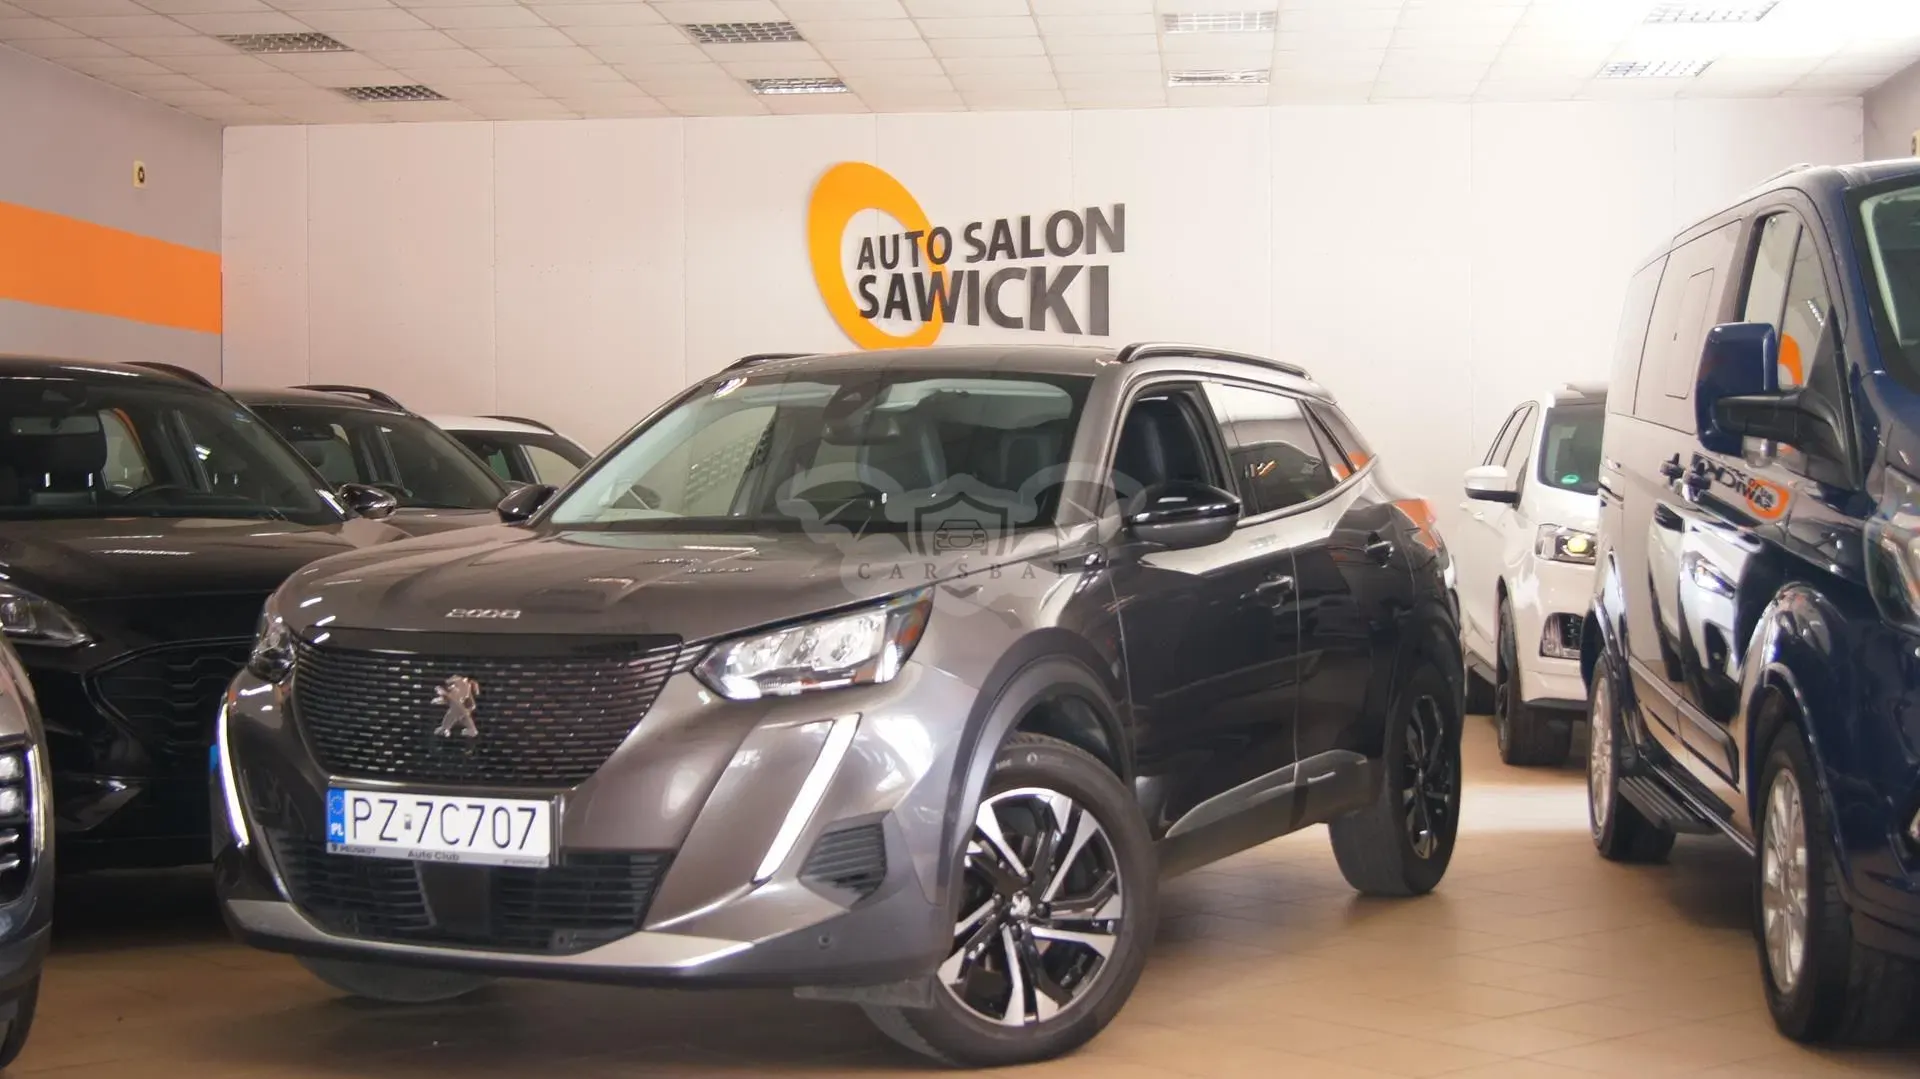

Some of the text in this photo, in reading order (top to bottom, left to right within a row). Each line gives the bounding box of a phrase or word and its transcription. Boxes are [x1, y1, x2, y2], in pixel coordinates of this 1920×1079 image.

[857, 203, 1126, 270] AUTO SALON
[858, 265, 1110, 337] SAWICKI
[445, 608, 521, 619] 2008
[331, 822, 344, 837] PL
[352, 797, 537, 850] PZ 7C707
[407, 850, 460, 862] Auto Club
